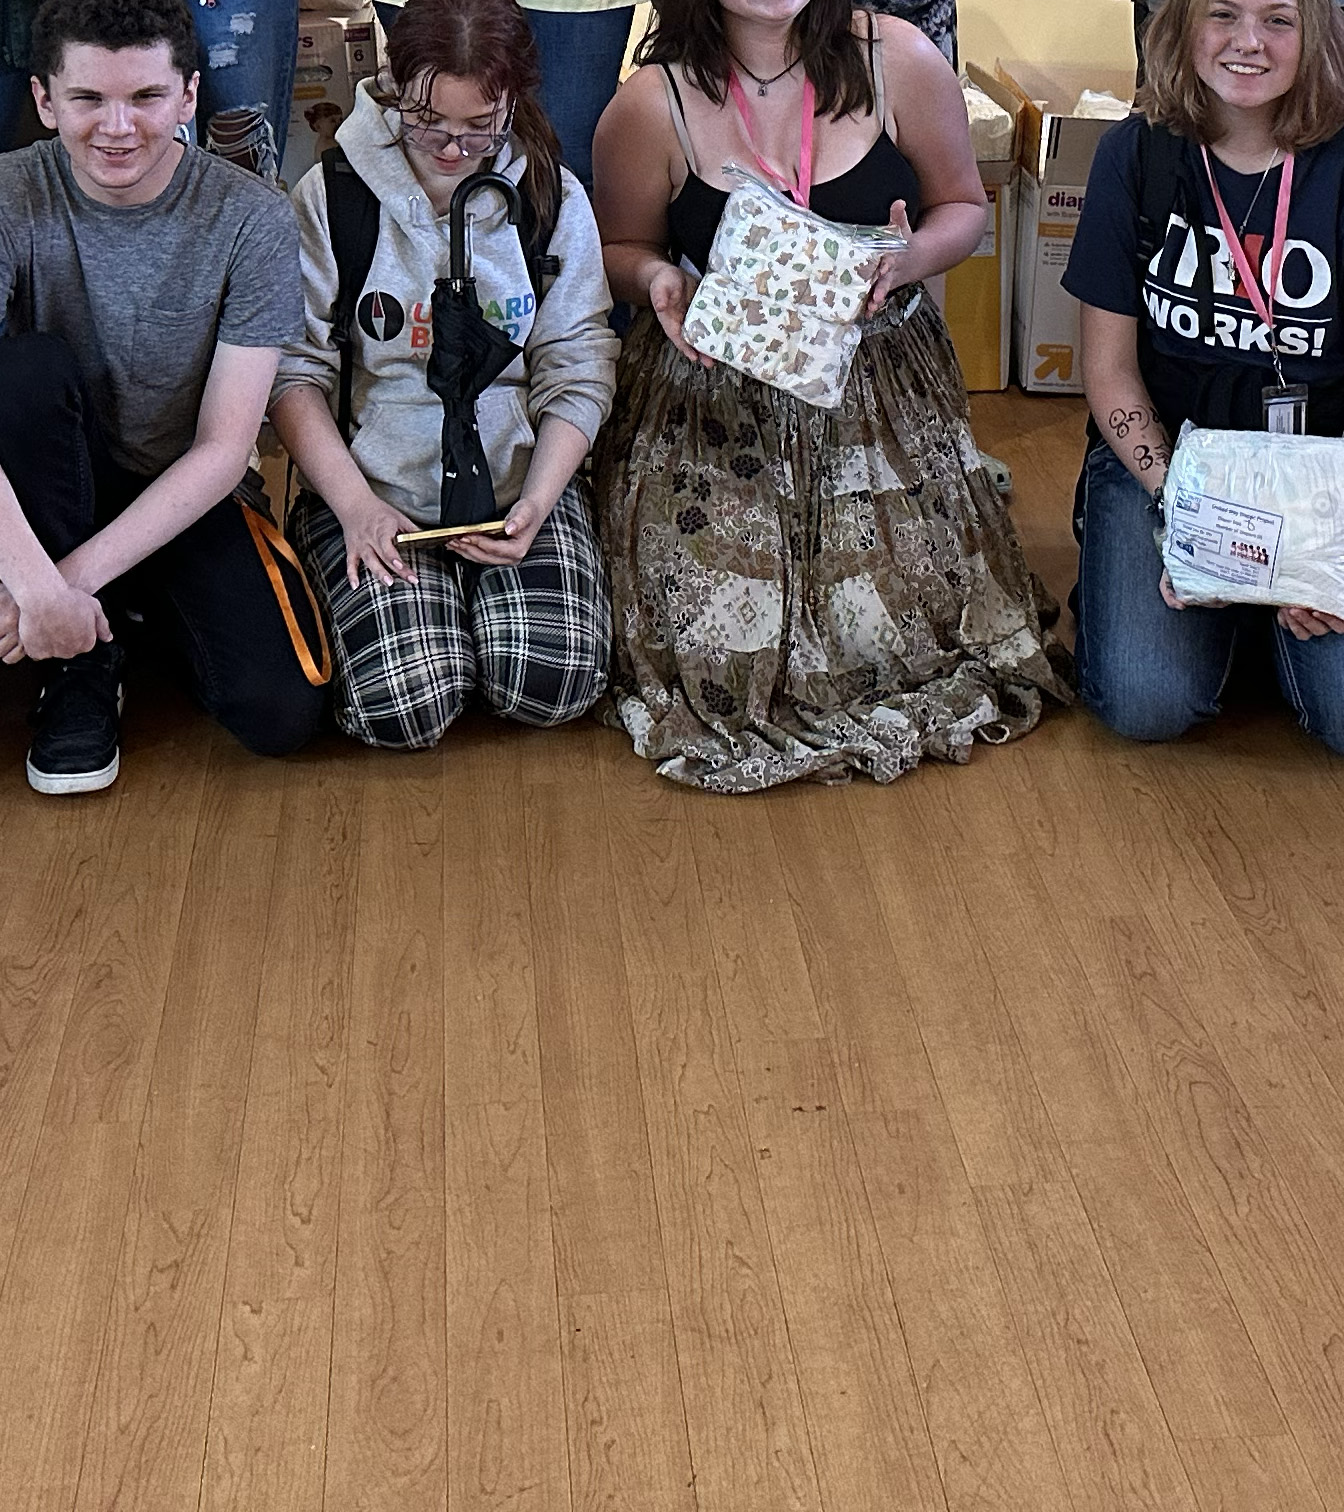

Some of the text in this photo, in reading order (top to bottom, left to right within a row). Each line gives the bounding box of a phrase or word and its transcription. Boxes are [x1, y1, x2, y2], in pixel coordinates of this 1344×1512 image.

[353, 49, 365, 62] 6
[1148, 212, 1332, 309] TRIO
[1142, 286, 1326, 357] WORKS!
